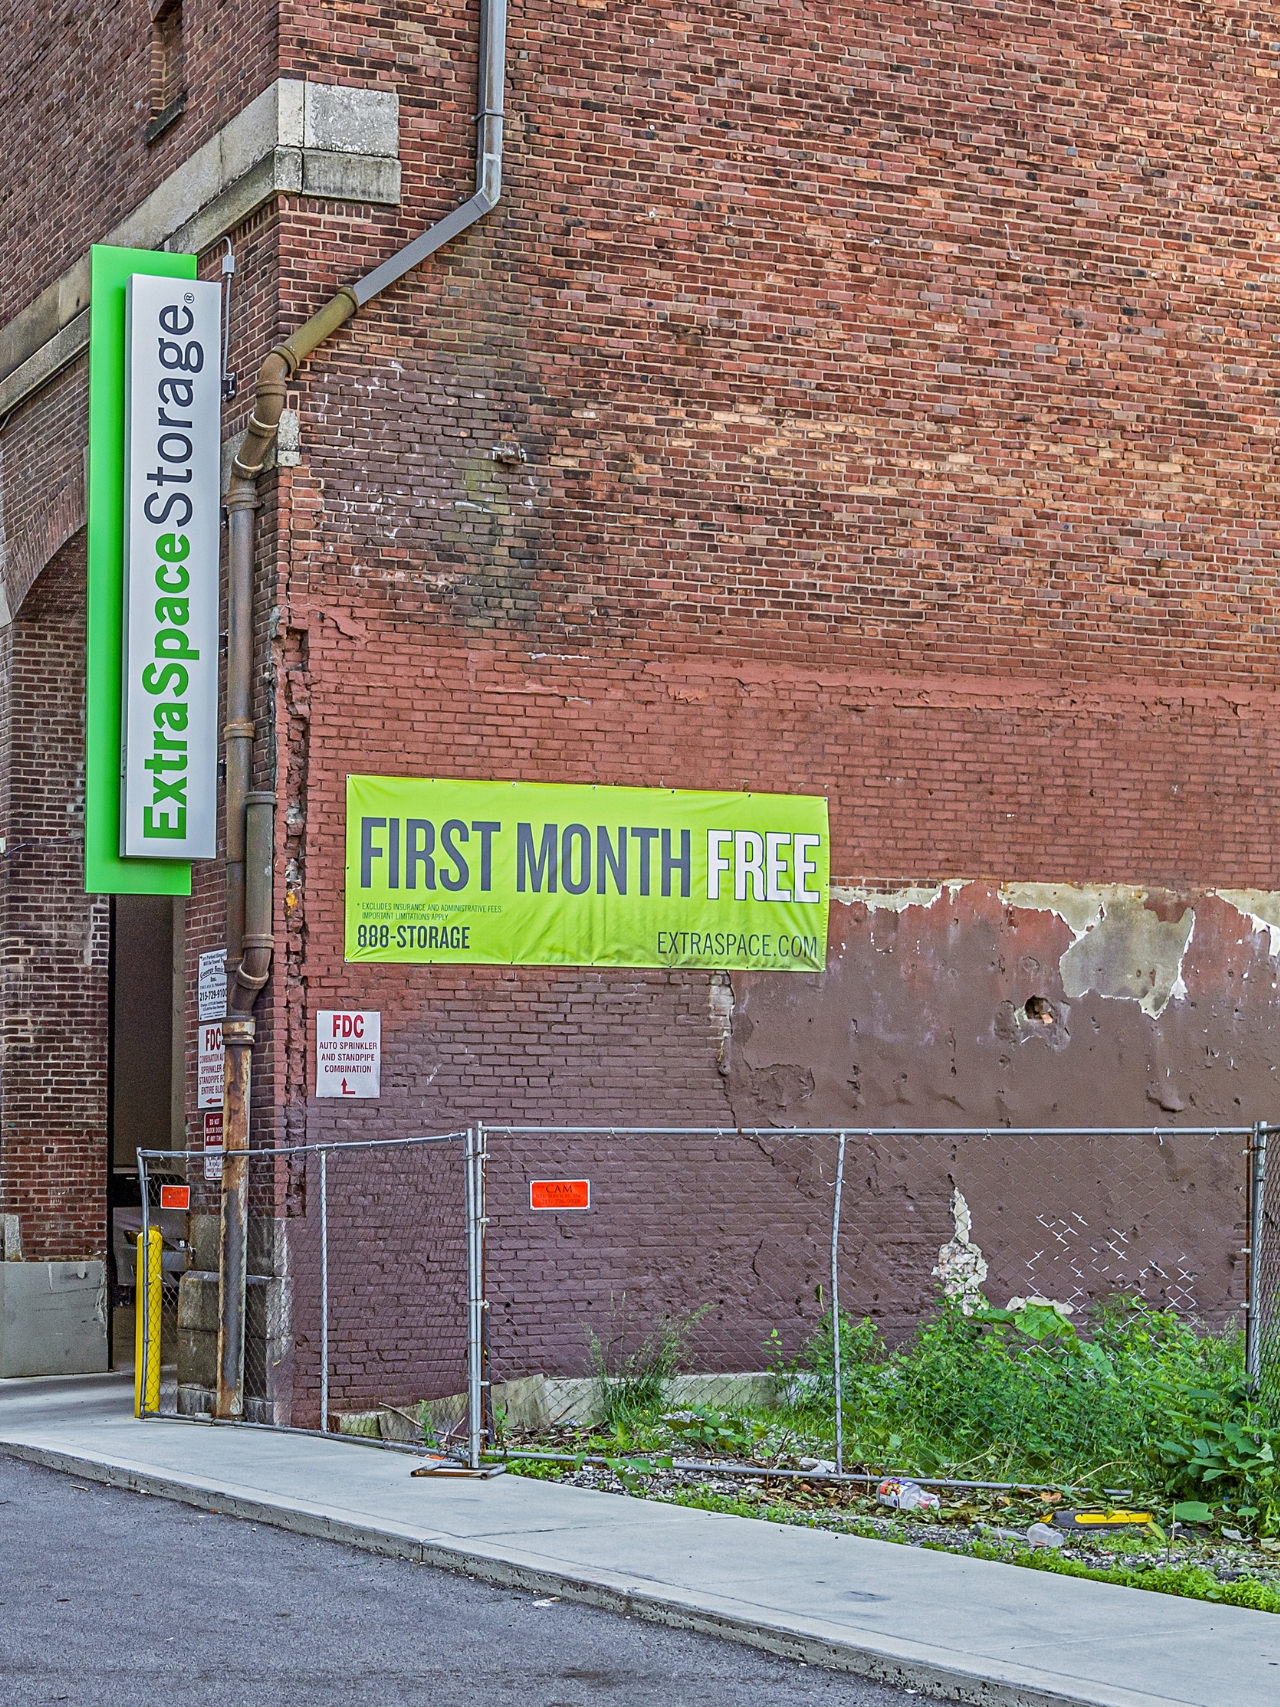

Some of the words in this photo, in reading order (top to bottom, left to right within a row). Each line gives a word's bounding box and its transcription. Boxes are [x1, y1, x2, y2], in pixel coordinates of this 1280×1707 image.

[360, 816, 502, 892] FIRST
[516, 822, 691, 897] MONTH
[706, 828, 821, 904] FREE
[361, 902, 392, 910] EXCLUDES
[393, 903, 426, 912] INSURANCE
[427, 904, 440, 912] AND
[440, 904, 487, 913] ADMINISTRATIVE
[361, 912, 394, 920] IMPORTANT
[395, 912, 430, 921] LIMITATIONS
[357, 924, 471, 949] 888-STORAGE
[657, 931, 817, 958] EXTRASPACE.COM
[332, 1014, 365, 1038] FDC
[205, 1027, 222, 1052] FDC
[319, 1042, 338, 1050] AUTO
[339, 1042, 378, 1050] SPRINKLER
[321, 1053, 336, 1061] AND
[337, 1053, 375, 1061] STANDPIPE
[201, 1064, 222, 1075] SPRINKLER
[324, 1065, 372, 1073] COMBINATION
[201, 1085, 214, 1095] ENTIRE
[545, 1184, 573, 1193] CAM
